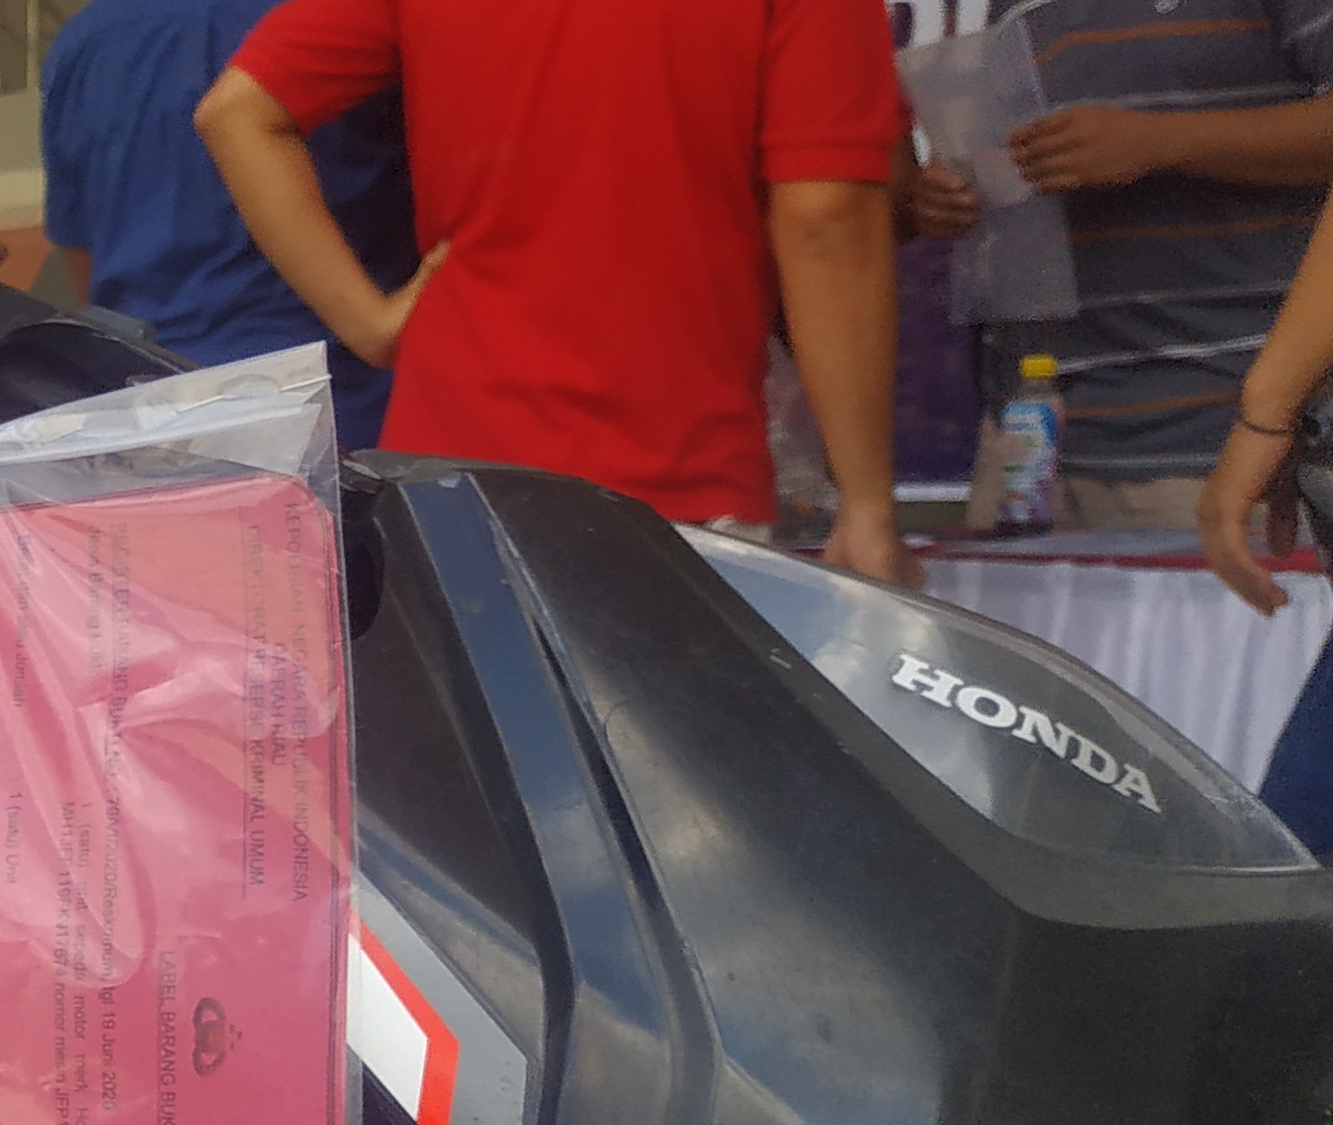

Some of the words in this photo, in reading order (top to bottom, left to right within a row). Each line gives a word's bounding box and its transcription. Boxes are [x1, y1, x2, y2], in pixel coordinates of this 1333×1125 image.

[284, 502, 302, 613] KEPOLISIAN
[289, 624, 305, 701] NEGARA
[270, 723, 287, 767] RIAU
[291, 706, 307, 797] REPUBLIK
[892, 654, 1162, 813] HONDA
[247, 739, 265, 823] KRIMINAL
[247, 830, 266, 887] UMUM
[292, 802, 310, 903] INDONESIA
[159, 951, 176, 1005] LABEL
[73, 994, 88, 1041] motor
[100, 1010, 115, 1030] 19
[73, 1053, 89, 1094] merk
[100, 1033, 115, 1067] Juni
[158, 1010, 176, 1088] BARANG
[99, 1071, 115, 1111] 2020
